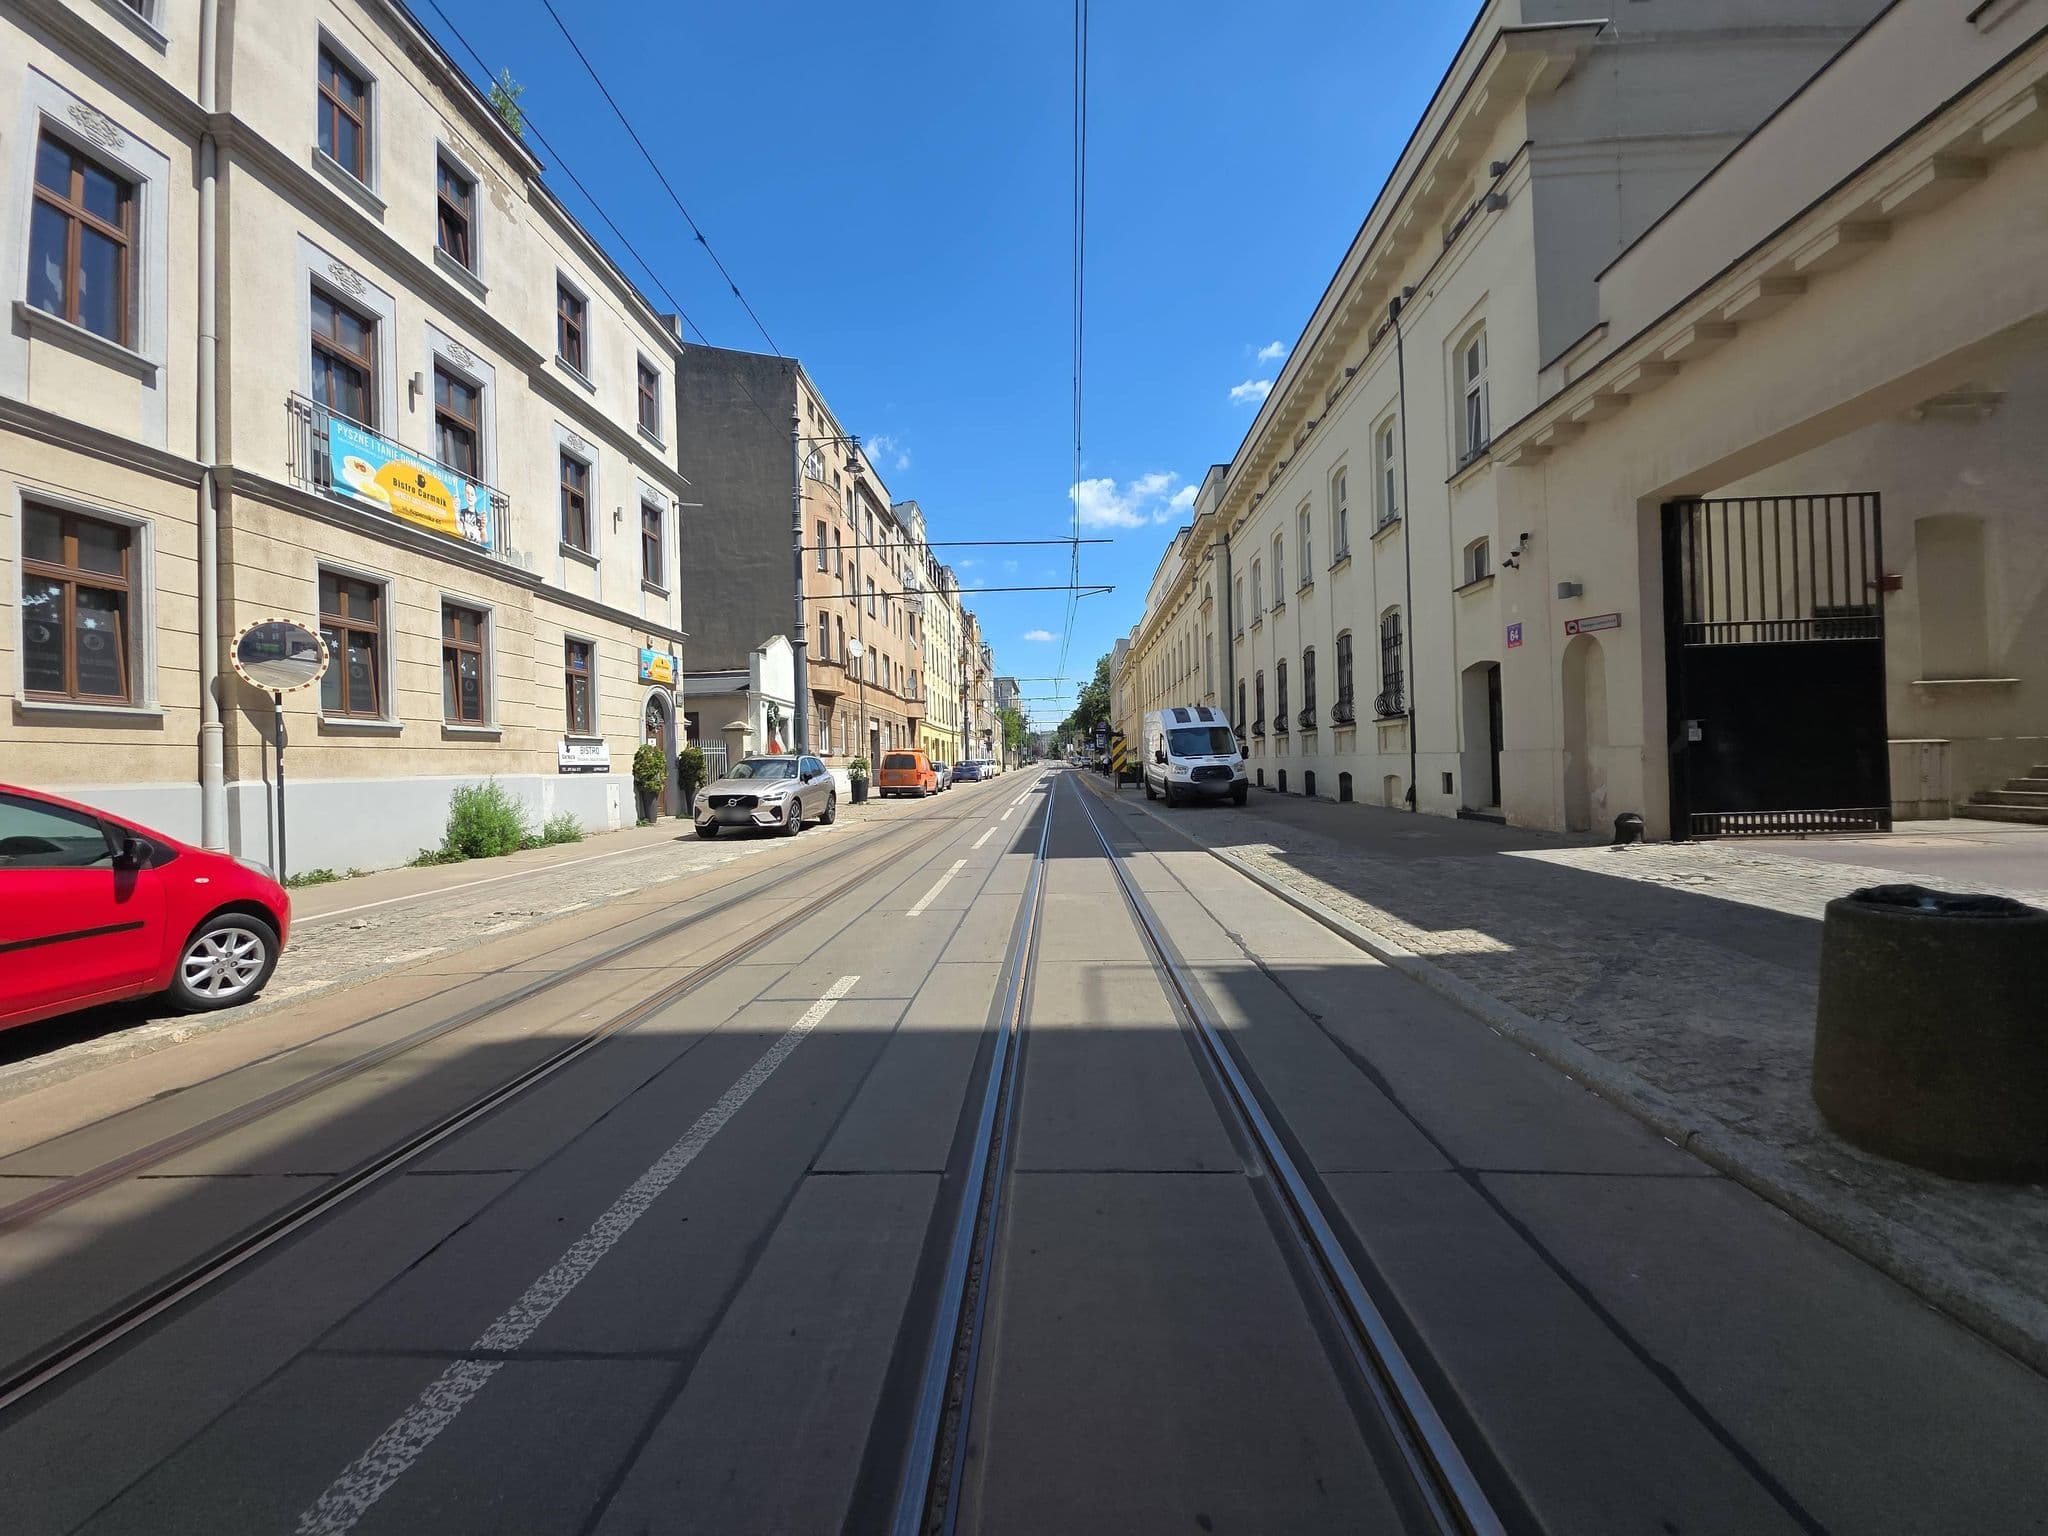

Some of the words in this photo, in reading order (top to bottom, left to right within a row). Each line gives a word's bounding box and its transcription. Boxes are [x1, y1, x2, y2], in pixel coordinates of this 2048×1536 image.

[337, 424, 369, 446] PYSZNE
[376, 443, 398, 460] TANIE
[392, 477, 416, 494] Bistro
[418, 488, 447, 507] Carmnik
[1510, 629, 1519, 642] 64
[580, 746, 600, 755] BISTRO
